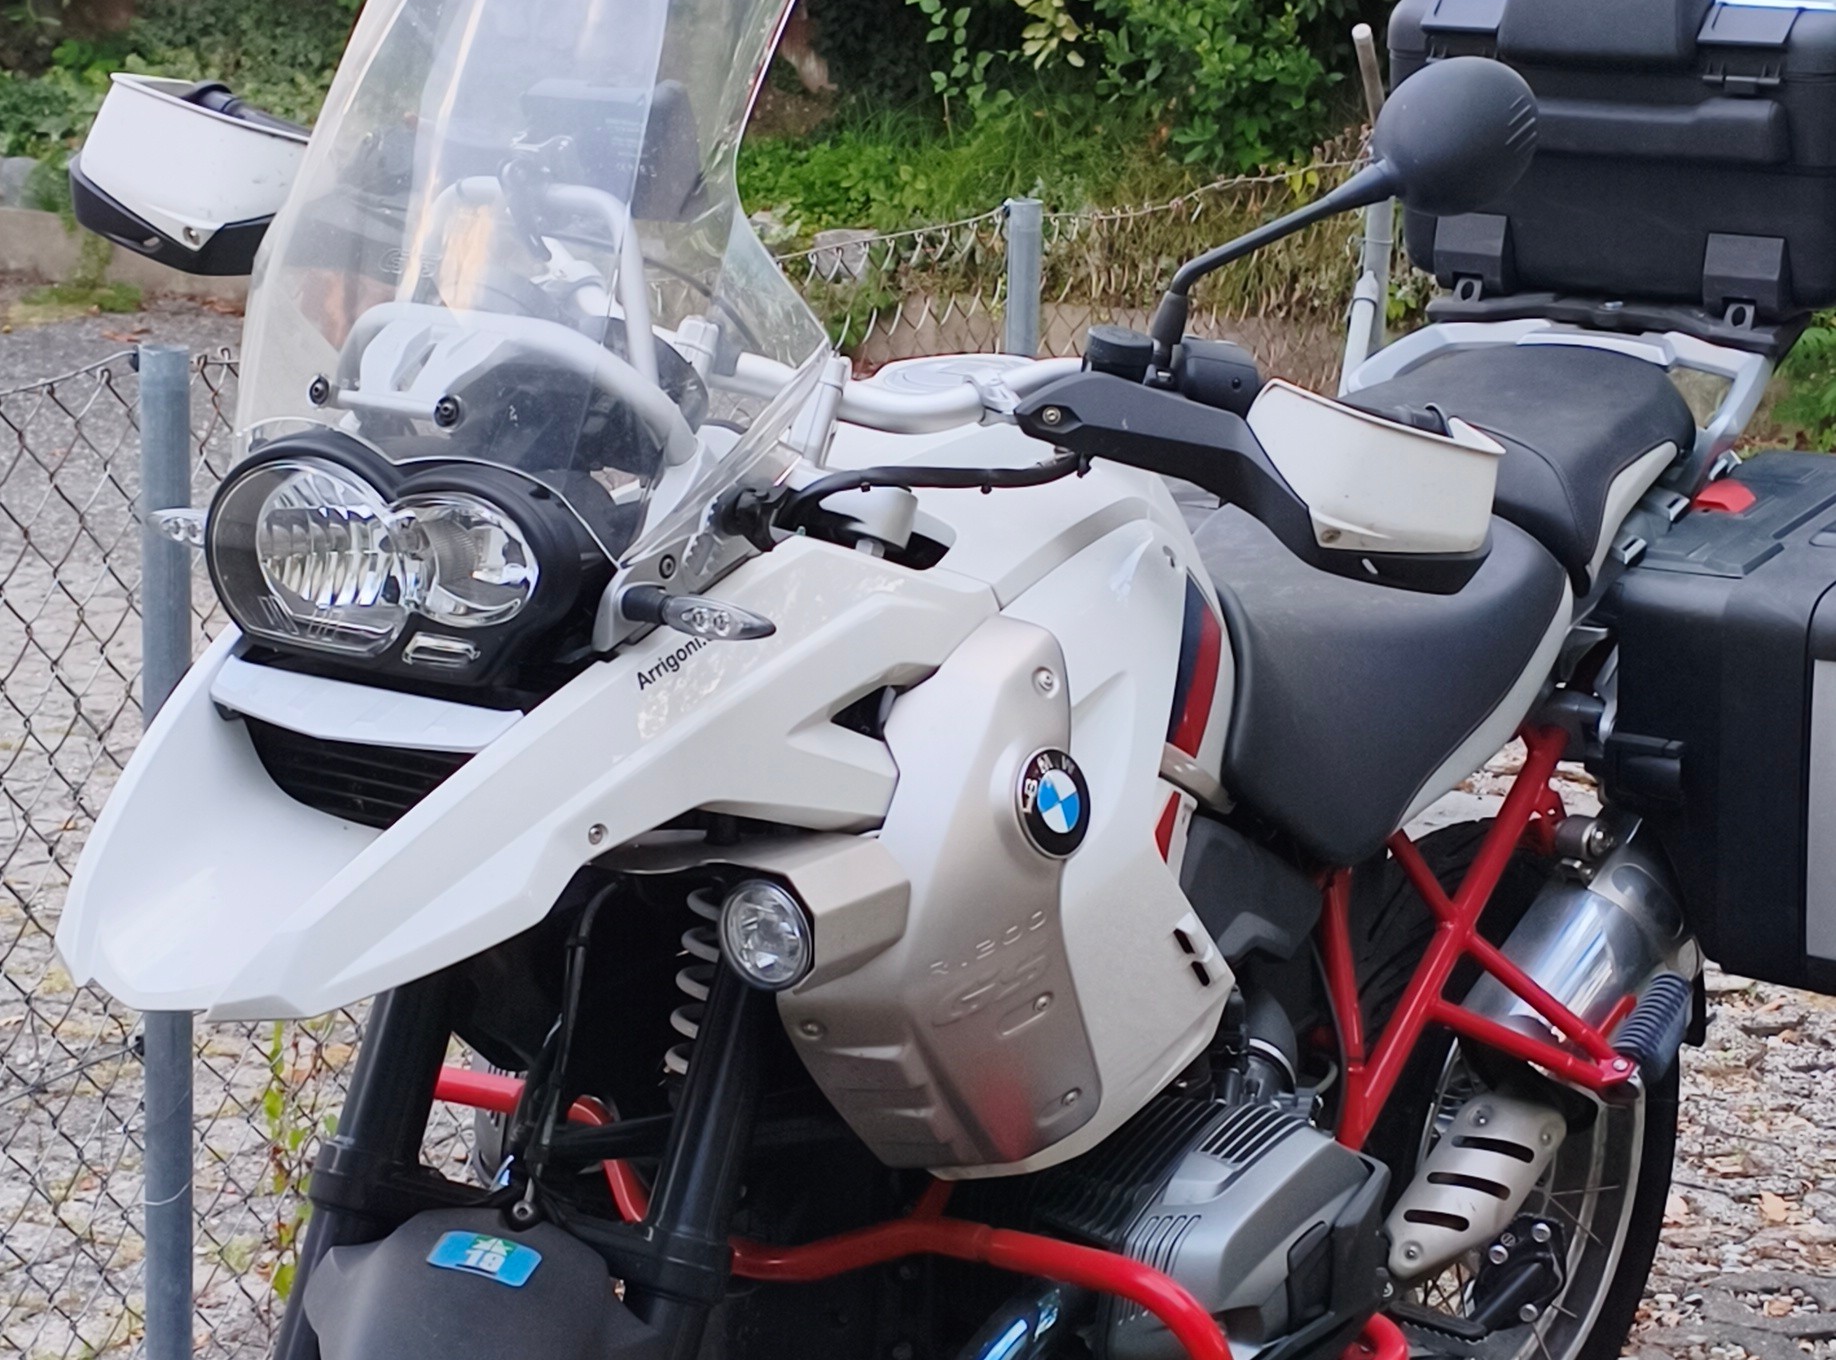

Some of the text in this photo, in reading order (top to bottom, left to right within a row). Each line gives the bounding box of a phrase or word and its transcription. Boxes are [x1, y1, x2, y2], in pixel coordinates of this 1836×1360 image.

[637, 637, 712, 691] Arrigoni.
[1023, 752, 1076, 808] BMW
[464, 1248, 506, 1274] 18
